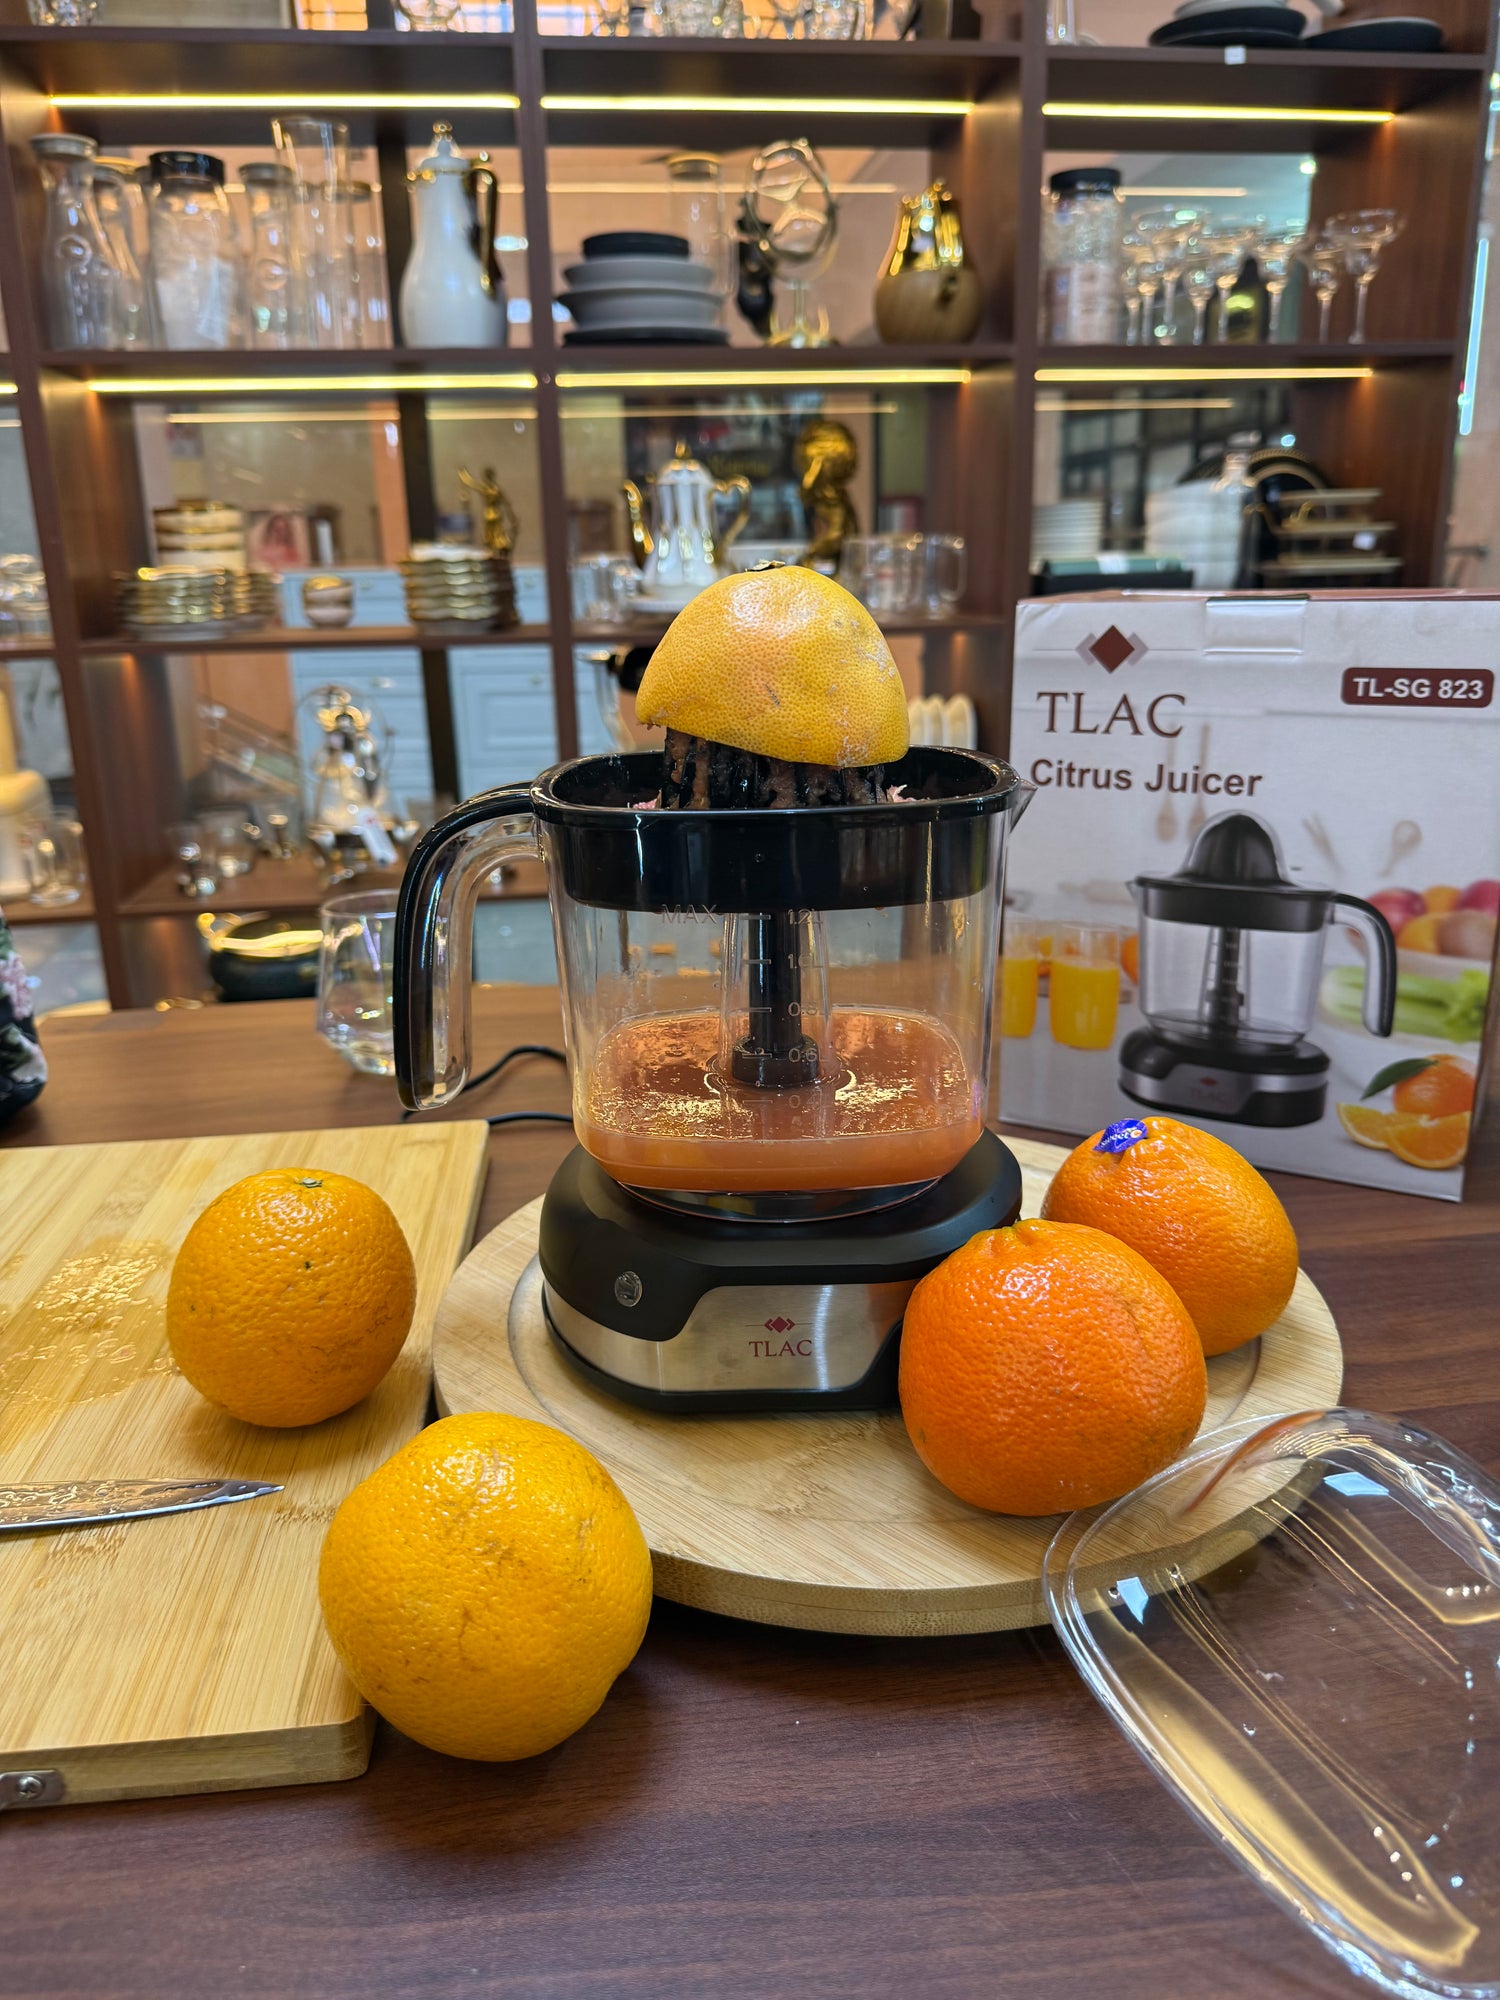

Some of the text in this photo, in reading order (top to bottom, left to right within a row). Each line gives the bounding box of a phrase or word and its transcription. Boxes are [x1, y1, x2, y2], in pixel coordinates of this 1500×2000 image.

[1352, 677, 1485, 700] TL-SG 823
[1036, 691, 1186, 739] TLAC
[1030, 758, 1263, 797] Citrus Juicer
[661, 903, 717, 925] MAX
[748, 1339, 812, 1357] TLAC
